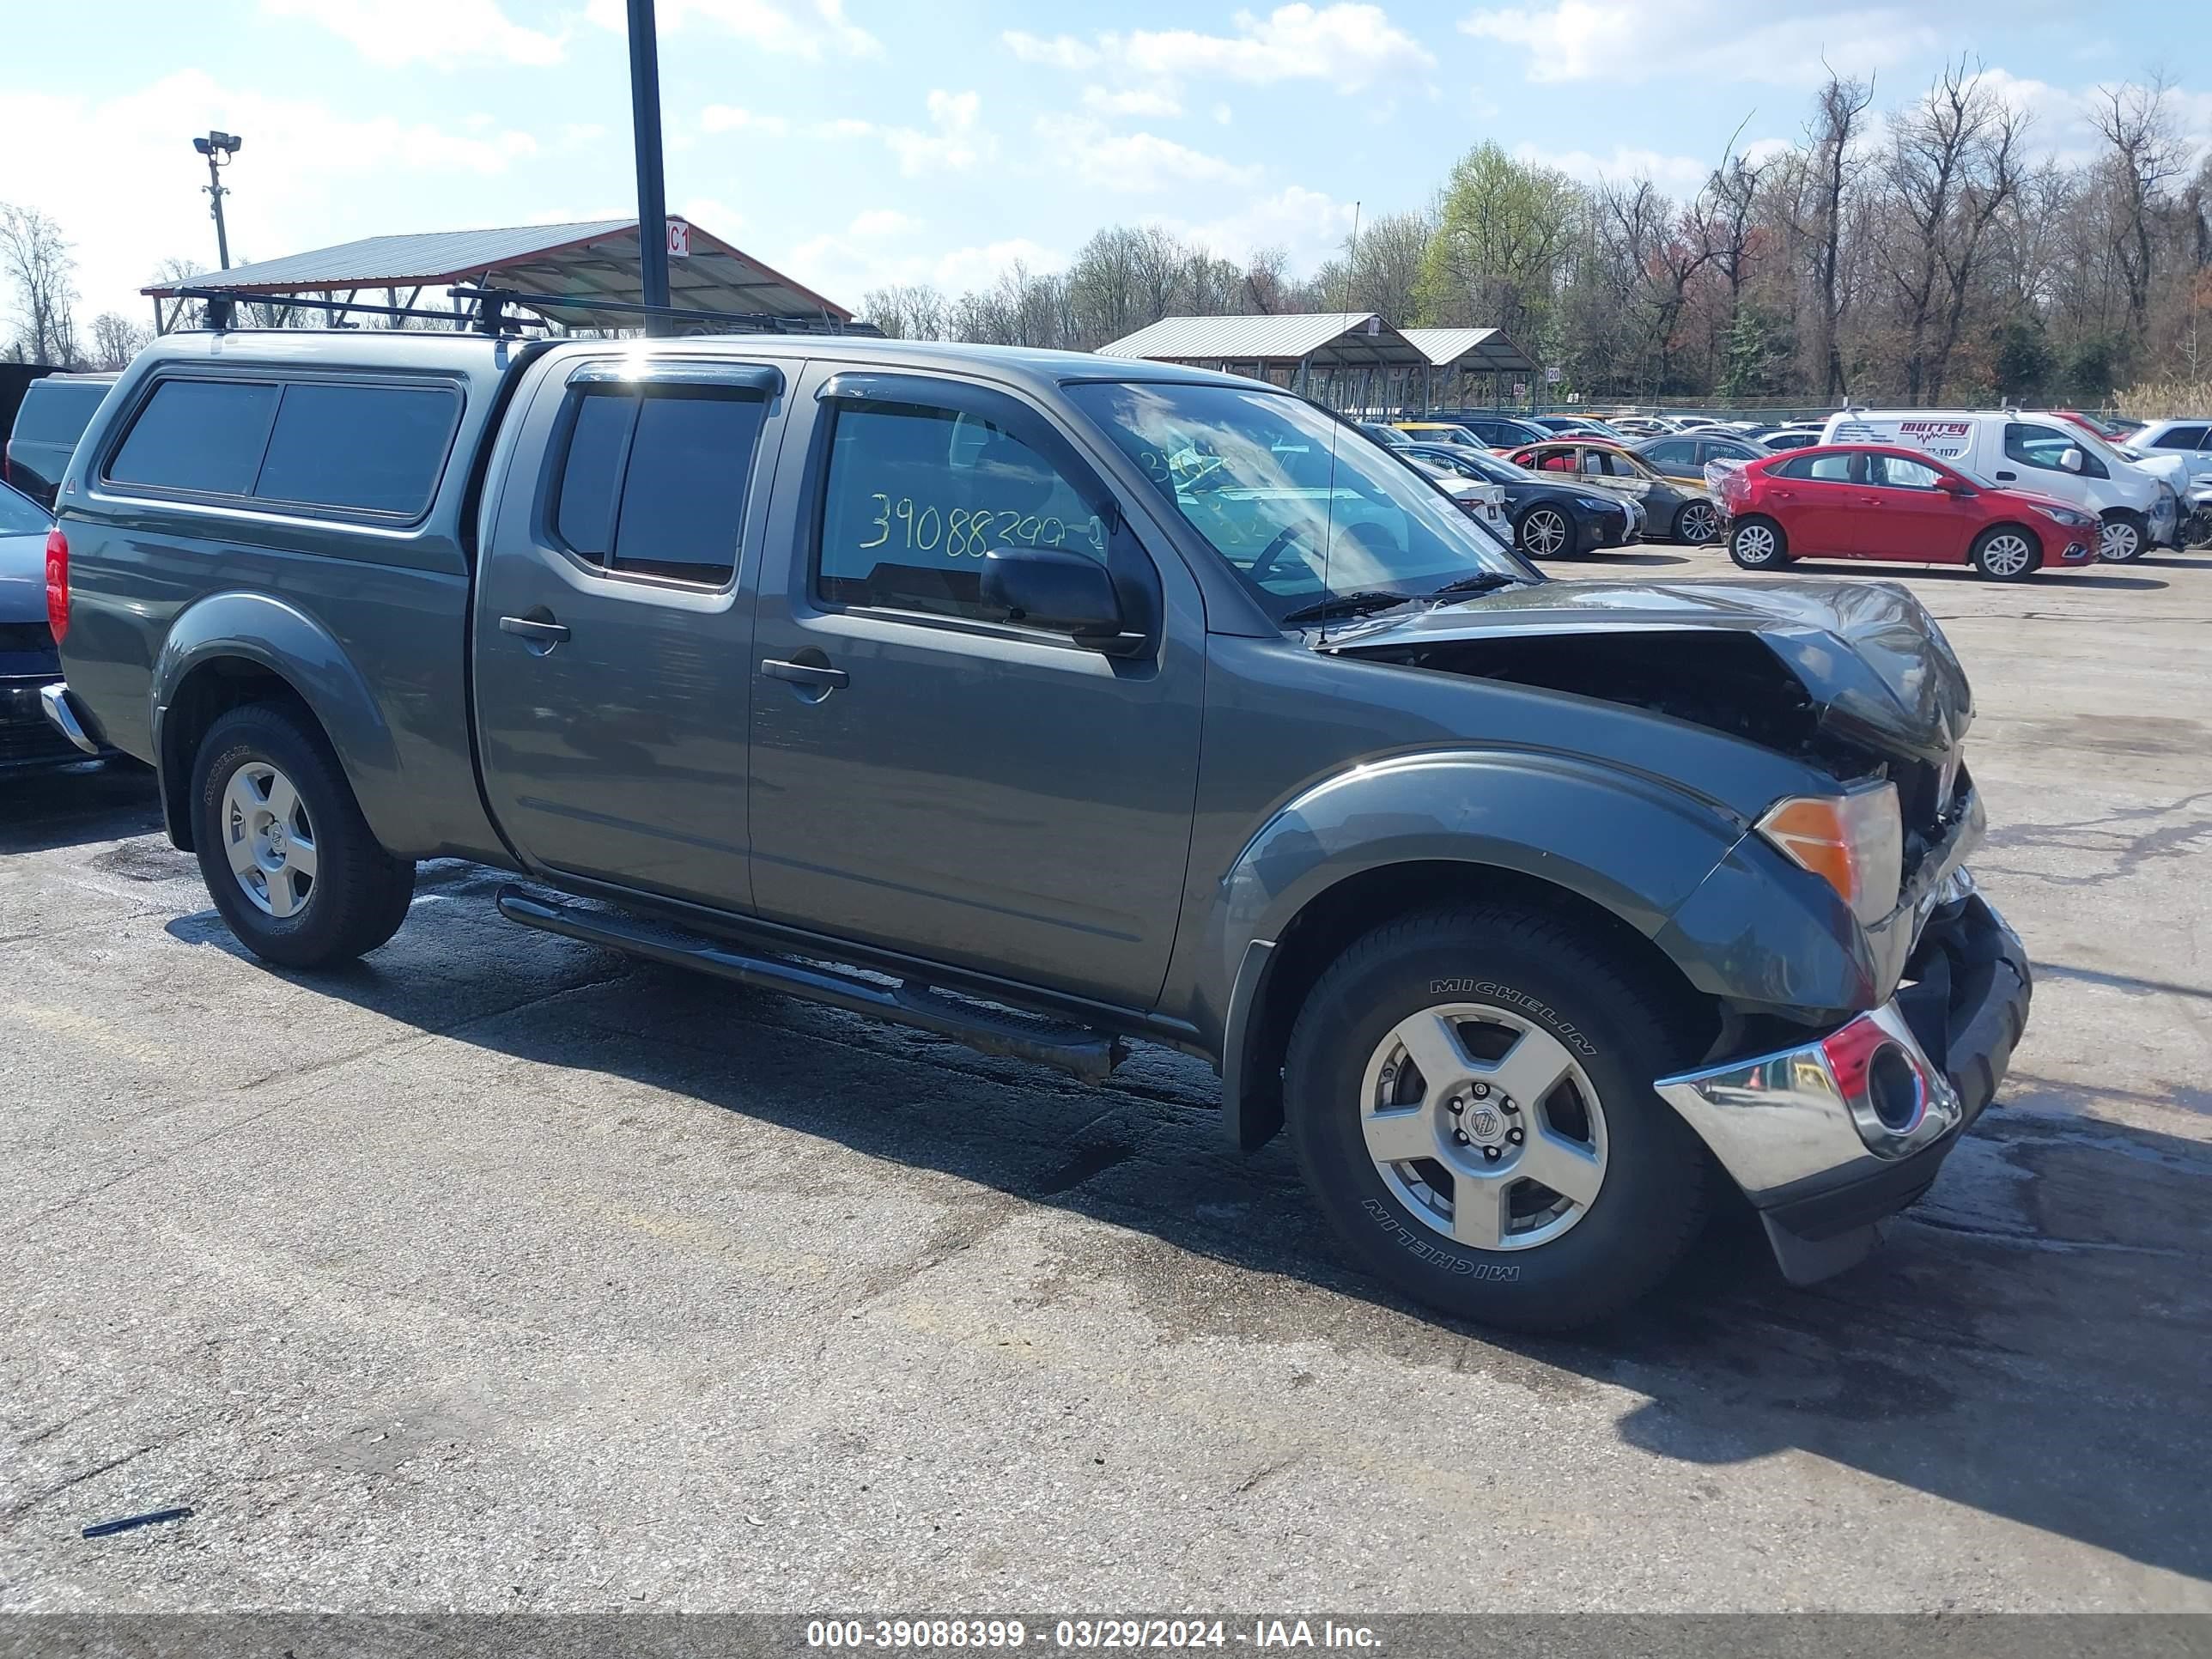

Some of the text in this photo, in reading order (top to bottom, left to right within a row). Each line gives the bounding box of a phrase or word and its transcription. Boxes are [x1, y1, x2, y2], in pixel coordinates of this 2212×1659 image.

[1549, 369, 1559, 380] 20
[1900, 422, 1970, 435] murrey
[204, 744, 251, 805] MICHELIN
[1430, 977, 1598, 1056] MICHELIN
[1361, 1199, 1521, 1282] MICHELIN
